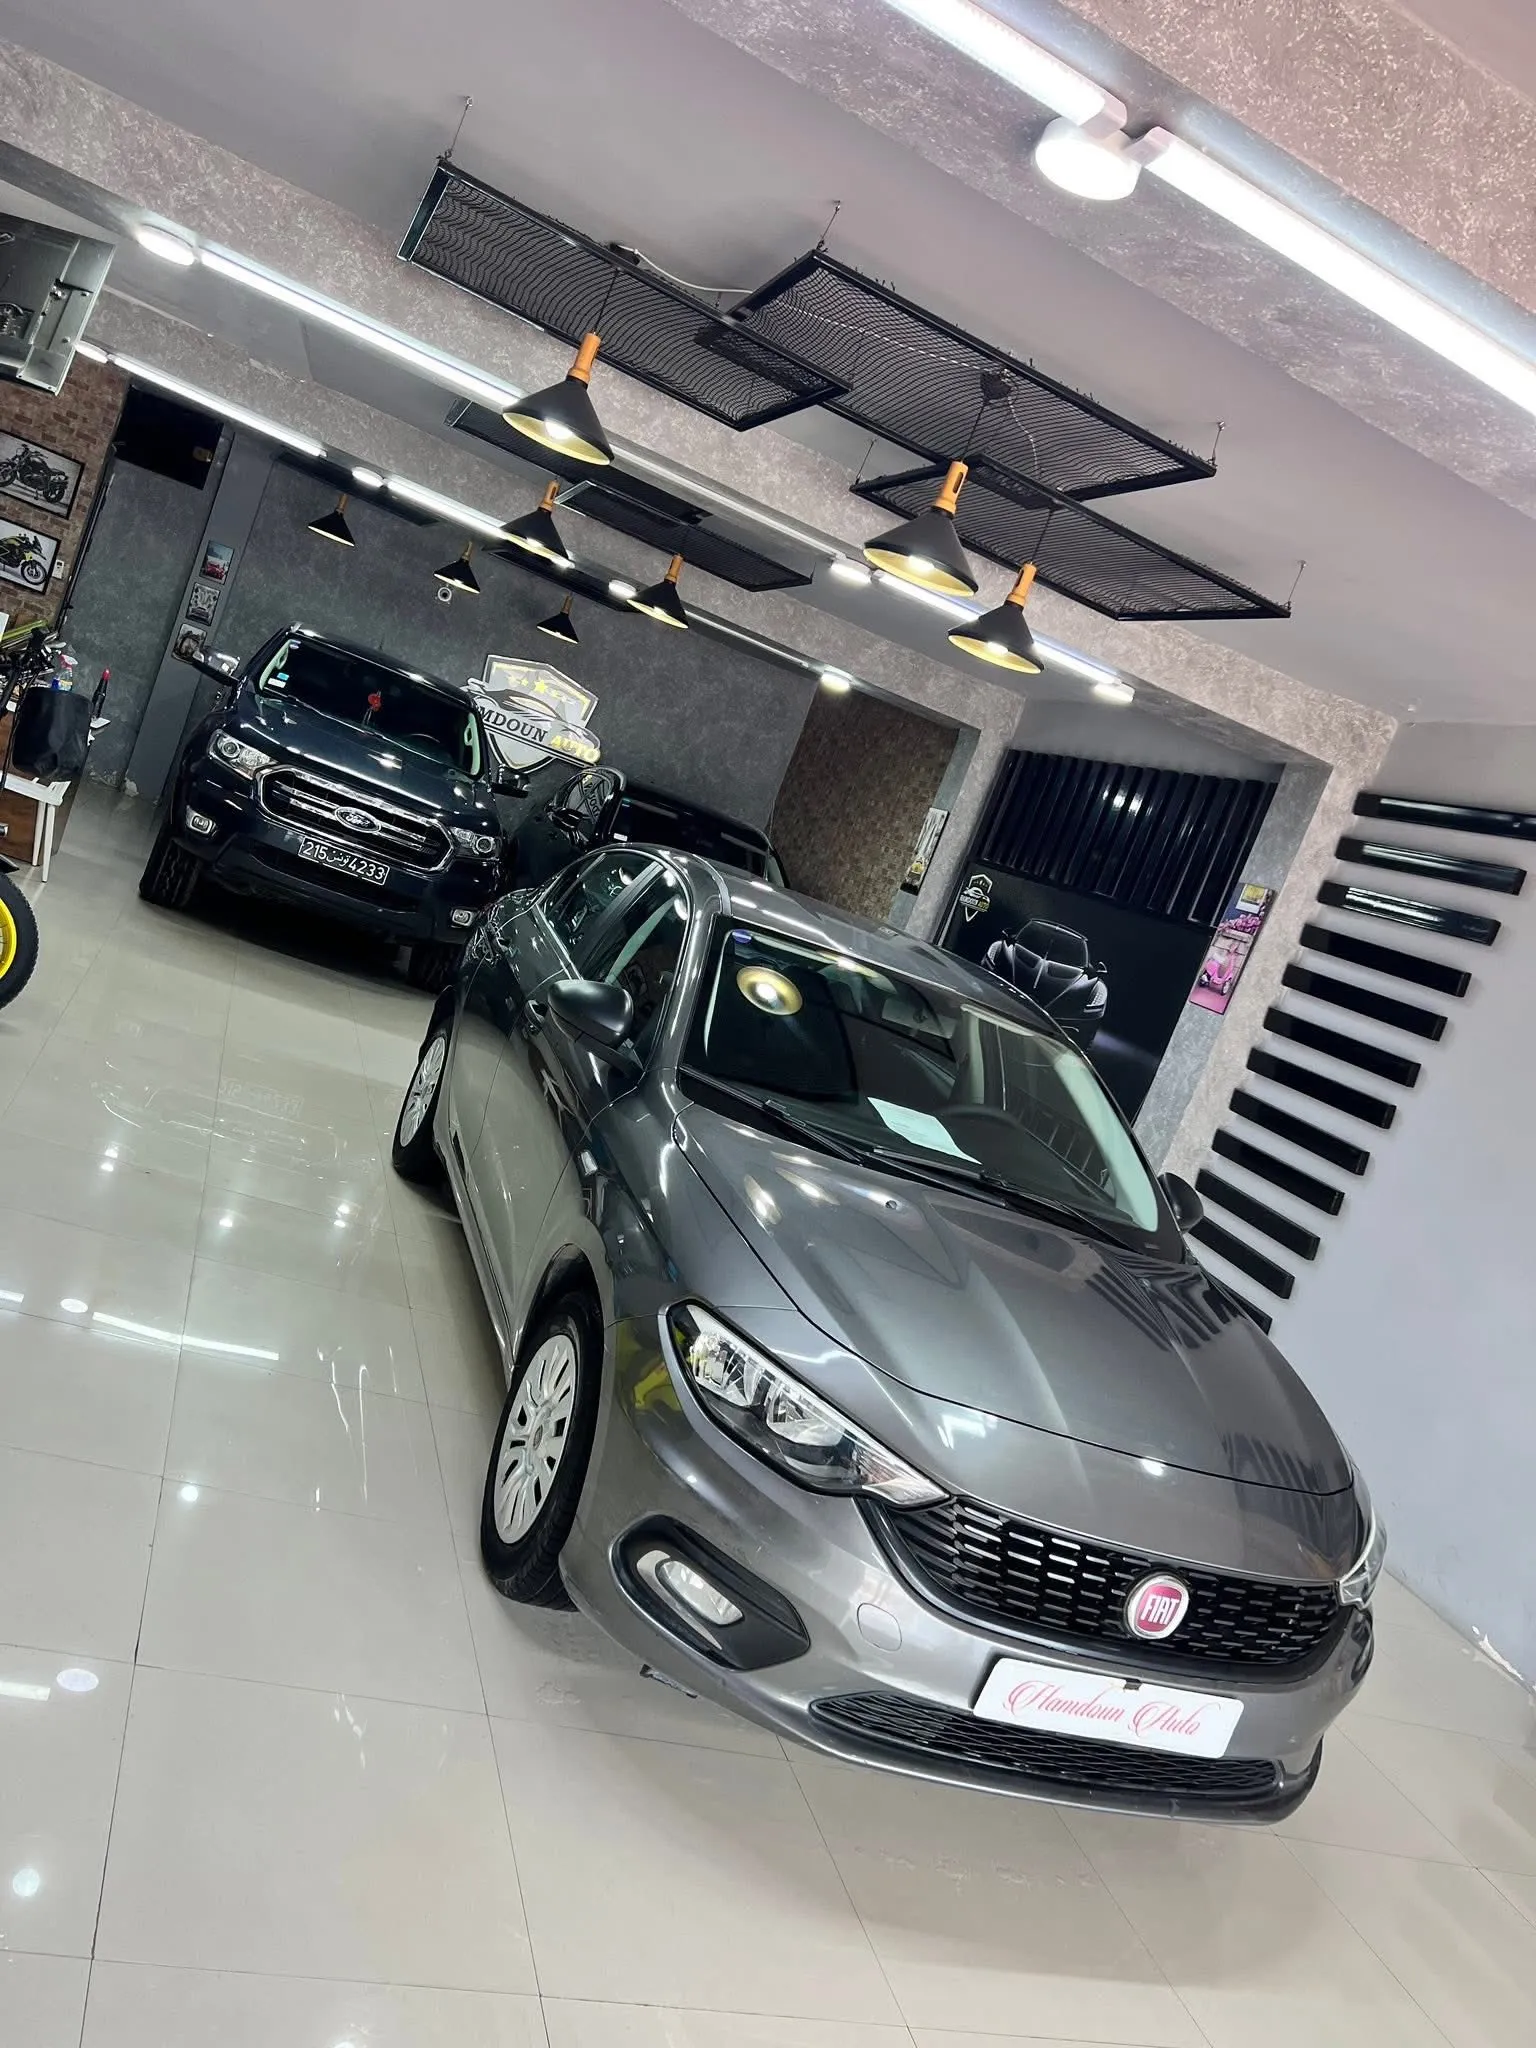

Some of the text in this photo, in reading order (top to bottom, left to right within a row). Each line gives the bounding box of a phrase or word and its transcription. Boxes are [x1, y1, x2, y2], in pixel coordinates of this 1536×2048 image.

[477, 705, 600, 763] MDOUN AUTO
[303, 841, 329, 860] 215
[348, 858, 385, 880] 4233
[1140, 1594, 1180, 1625] FIAT
[1002, 1680, 1221, 1737] Hamdoun Auto
